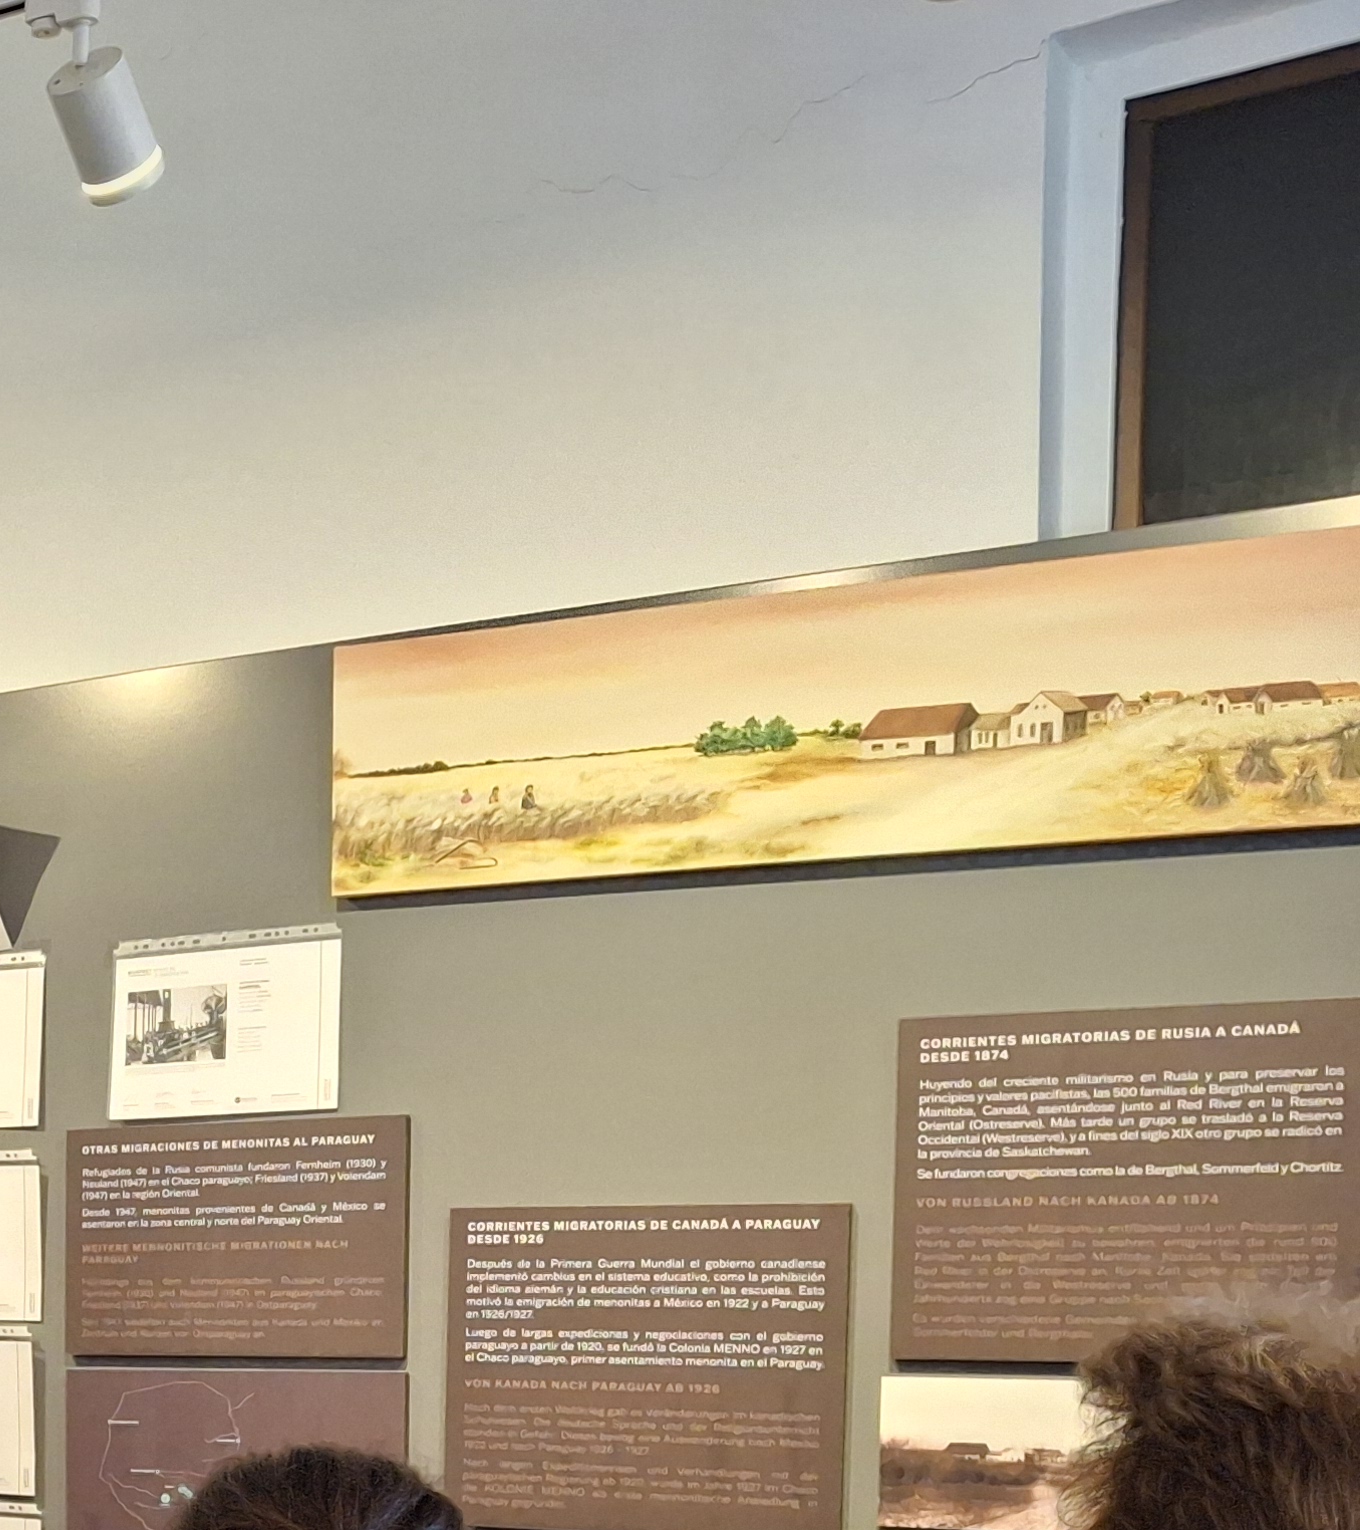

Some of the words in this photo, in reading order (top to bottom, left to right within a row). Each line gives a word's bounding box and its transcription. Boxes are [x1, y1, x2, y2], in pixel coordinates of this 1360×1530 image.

[920, 1034, 1016, 1049] CORRIENTES
[1021, 1030, 1130, 1044] MIGRATORIAS
[1135, 1028, 1156, 1040] DE
[1161, 1027, 1210, 1039] RUSIA
[1215, 1026, 1226, 1037] A
[1231, 1021, 1300, 1036] CANADÁ
[920, 1050, 969, 1063] DESDE
[974, 1049, 1008, 1060] 1874
[919, 1078, 972, 1091] Huyendo
[978, 1077, 997, 1087] del
[1003, 1076, 1059, 1087] creciente
[1065, 1073, 1134, 1084] militarismo
[1140, 1073, 1156, 1082] en
[1163, 1070, 1198, 1081] Rusia
[1205, 1072, 1212, 1082] y
[1219, 1070, 1248, 1082] para
[1255, 1068, 1318, 1080] preservar
[1325, 1064, 1344, 1076] los
[919, 1092, 975, 1105] principios
[977, 1094, 984, 1104] y
[985, 1091, 1028, 1101] valores
[1093, 1088, 1110, 1098] las
[1112, 1086, 1137, 1097] 500
[1139, 1085, 1187, 1096] familias
[1189, 1084, 1206, 1095] de
[1265, 1082, 1333, 1094] emigraron
[1335, 1081, 1343, 1090] a
[82, 1144, 117, 1154] OTRAS
[121, 1141, 199, 1152] MIGRACIONES
[203, 1140, 218, 1149] DE
[221, 1137, 290, 1149] MENONITAS
[293, 1137, 308, 1146] AL
[311, 1134, 374, 1145] PARAGUAY
[917, 1148, 927, 1158] la
[929, 1147, 982, 1161] provincia
[984, 1147, 1000, 1157] de
[467, 1221, 549, 1231] CORRIENTES
[553, 1220, 646, 1230] MIGRATORIAS
[650, 1220, 668, 1230] DE
[672, 1217, 728, 1229] CANADÁ
[732, 1219, 741, 1229] A
[745, 1218, 819, 1229] PARAGUAY
[467, 1234, 509, 1244] DESDE
[513, 1233, 543, 1244] 1926
[467, 1258, 512, 1270] Después
[517, 1259, 530, 1268] de
[536, 1258, 545, 1268] la
[550, 1258, 592, 1268] Primera
[597, 1258, 635, 1268] Guerra
[640, 1258, 684, 1268] Mundial
[689, 1259, 700, 1268] el
[705, 1258, 755, 1270] gobierno
[760, 1258, 825, 1268] canadiense
[466, 1296, 501, 1306] motivó
[504, 1296, 513, 1306] la
[516, 1296, 574, 1309] emigración
[577, 1297, 590, 1306] de
[593, 1298, 650, 1307] menonitas
[653, 1299, 660, 1307] a
[663, 1297, 703, 1307] México
[723, 1298, 749, 1308] 1922
[752, 1300, 758, 1310] y
[761, 1300, 768, 1308] a
[771, 1298, 824, 1311] Paraguay
[465, 1378, 490, 1388] VON
[551, 1380, 586, 1390] NACH
[592, 1381, 661, 1391] PARAGUAY
[689, 1383, 719, 1393] 1926
